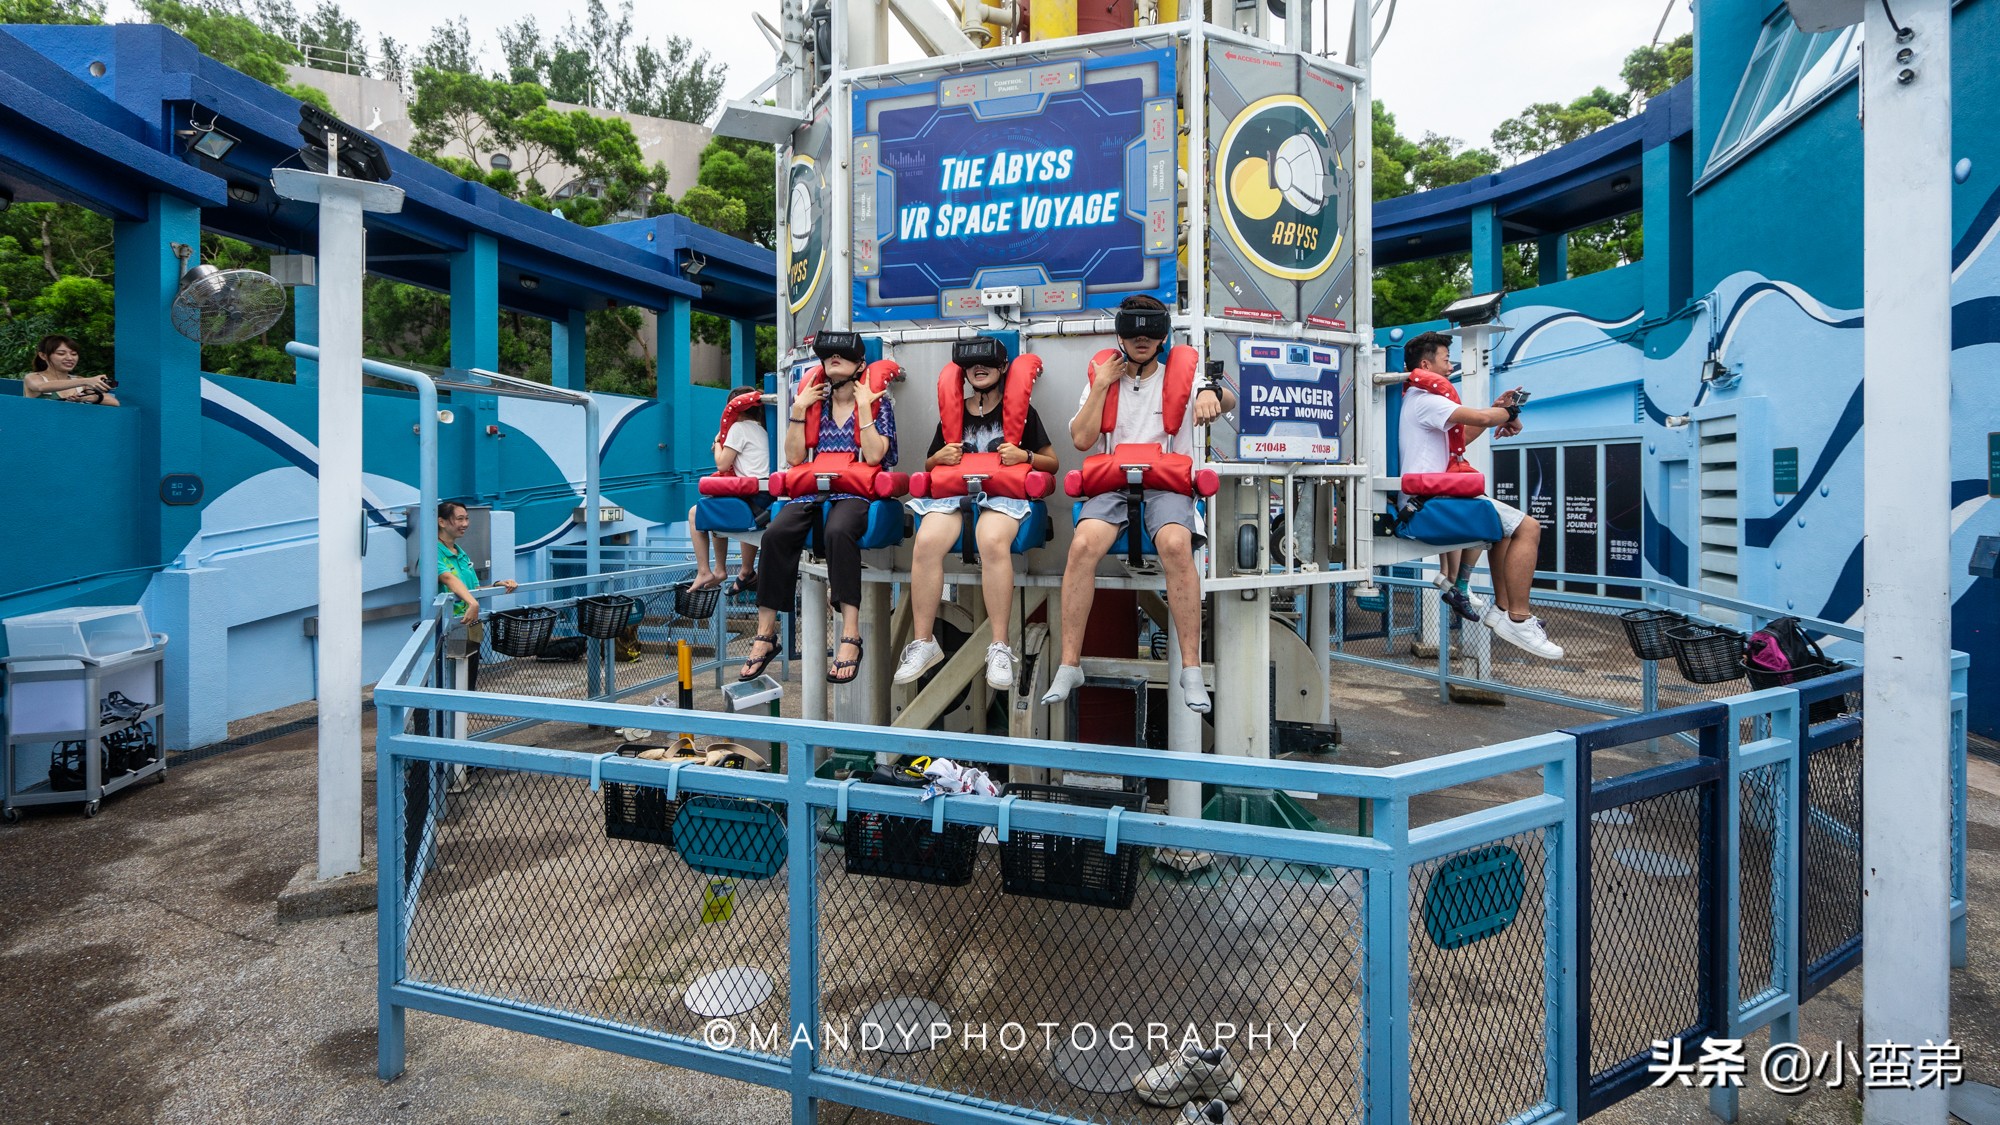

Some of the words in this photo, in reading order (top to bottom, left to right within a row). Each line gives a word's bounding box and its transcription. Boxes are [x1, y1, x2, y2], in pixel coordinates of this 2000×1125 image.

[1237, 55, 1261, 64] ACCESS
[1263, 58, 1283, 68] PANEL
[994, 79, 1023, 87] CONTROL
[942, 156, 990, 191] THE
[988, 149, 1073, 186] ABYSS
[901, 206, 930, 240] VR
[936, 201, 1014, 237] SPACE
[1020, 191, 1120, 230] VOYAGE
[1271, 221, 1319, 250] ABYSS
[1233, 286, 1243, 296] 01
[1233, 309, 1260, 317] RESTRICTED
[1251, 385, 1334, 407] DANGER
[1226, 412, 1235, 422] 01
[1251, 406, 1289, 417] FAST
[1295, 406, 1334, 420] MOVING
[1255, 442, 1287, 452] Z104B
[1312, 444, 1331, 453] Z103B
[608, 510, 620, 520] 出口
[1566, 521, 1598, 529] JOURNEY
